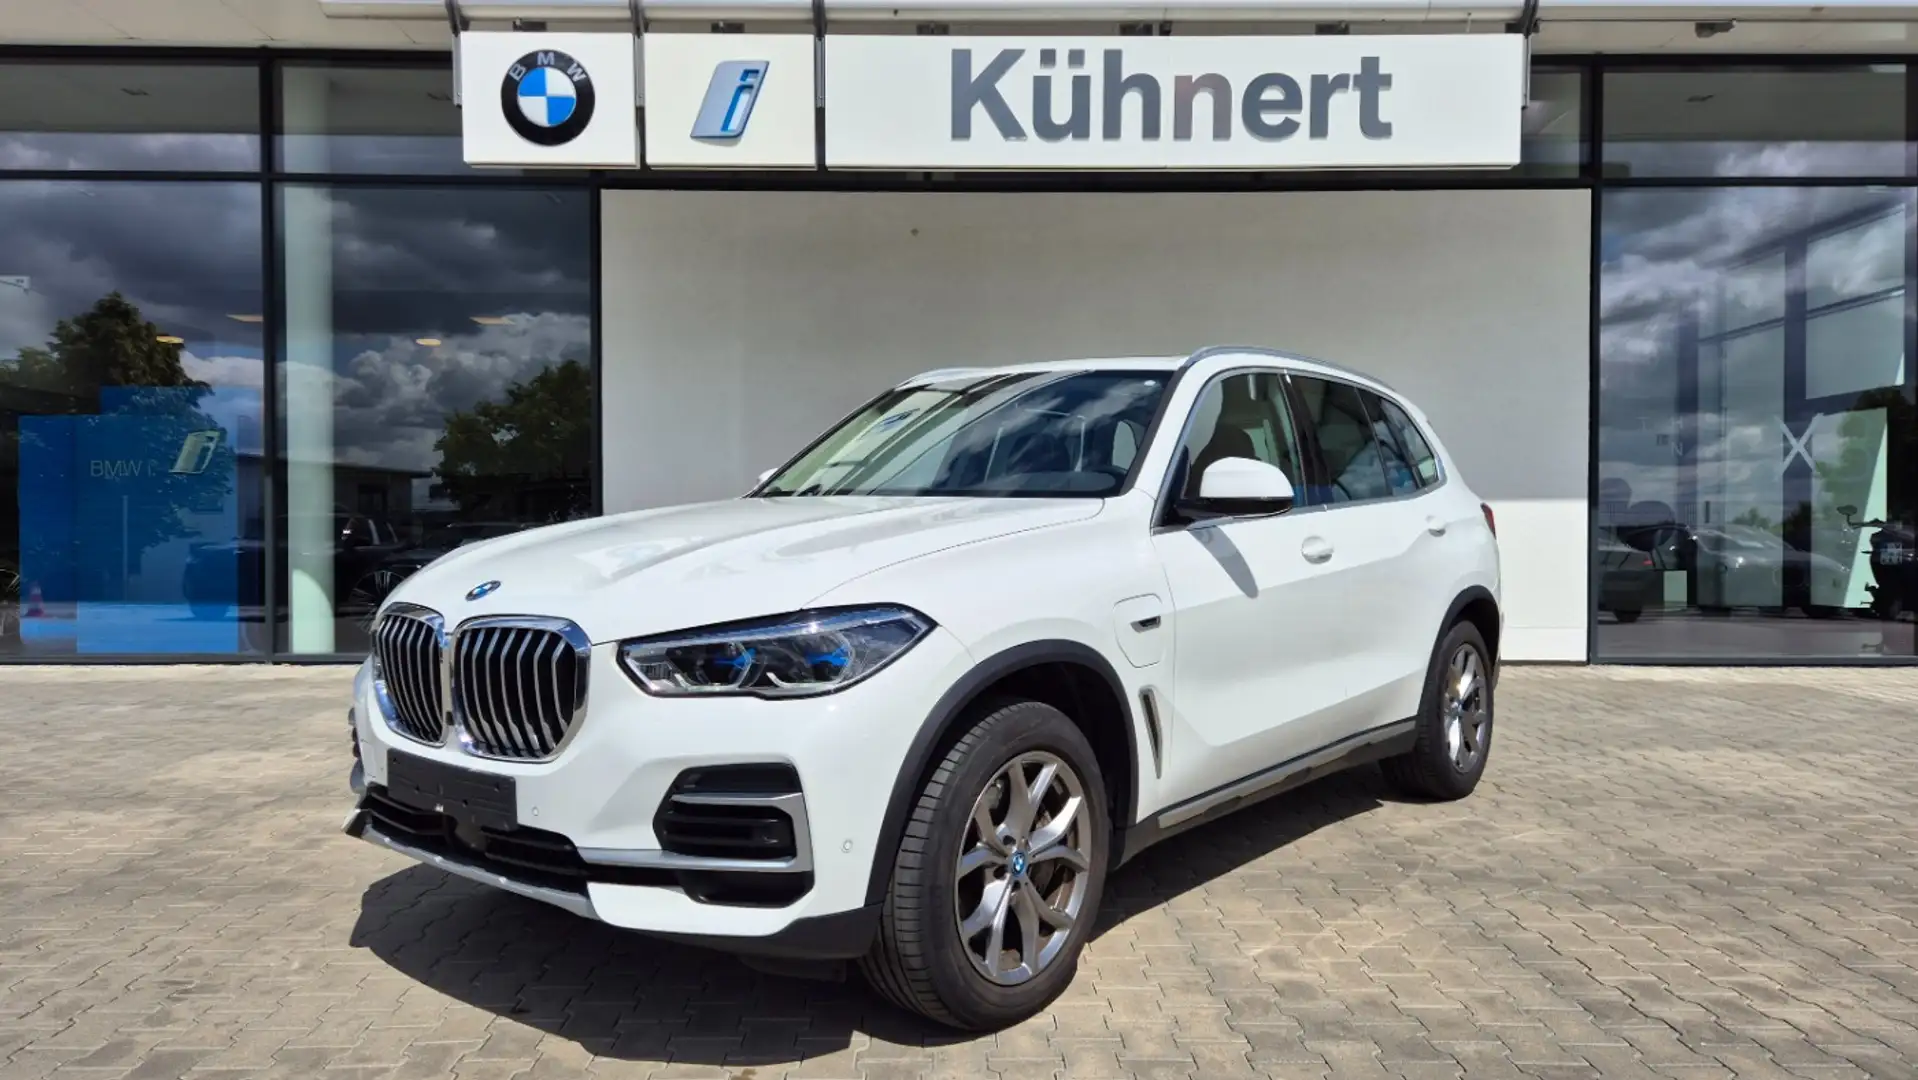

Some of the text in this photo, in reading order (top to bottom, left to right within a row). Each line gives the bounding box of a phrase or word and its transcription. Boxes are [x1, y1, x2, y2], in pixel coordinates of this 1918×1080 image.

[508, 51, 587, 82] BMW
[951, 48, 1393, 141] Kühnert
[90, 459, 143, 478] BMW
